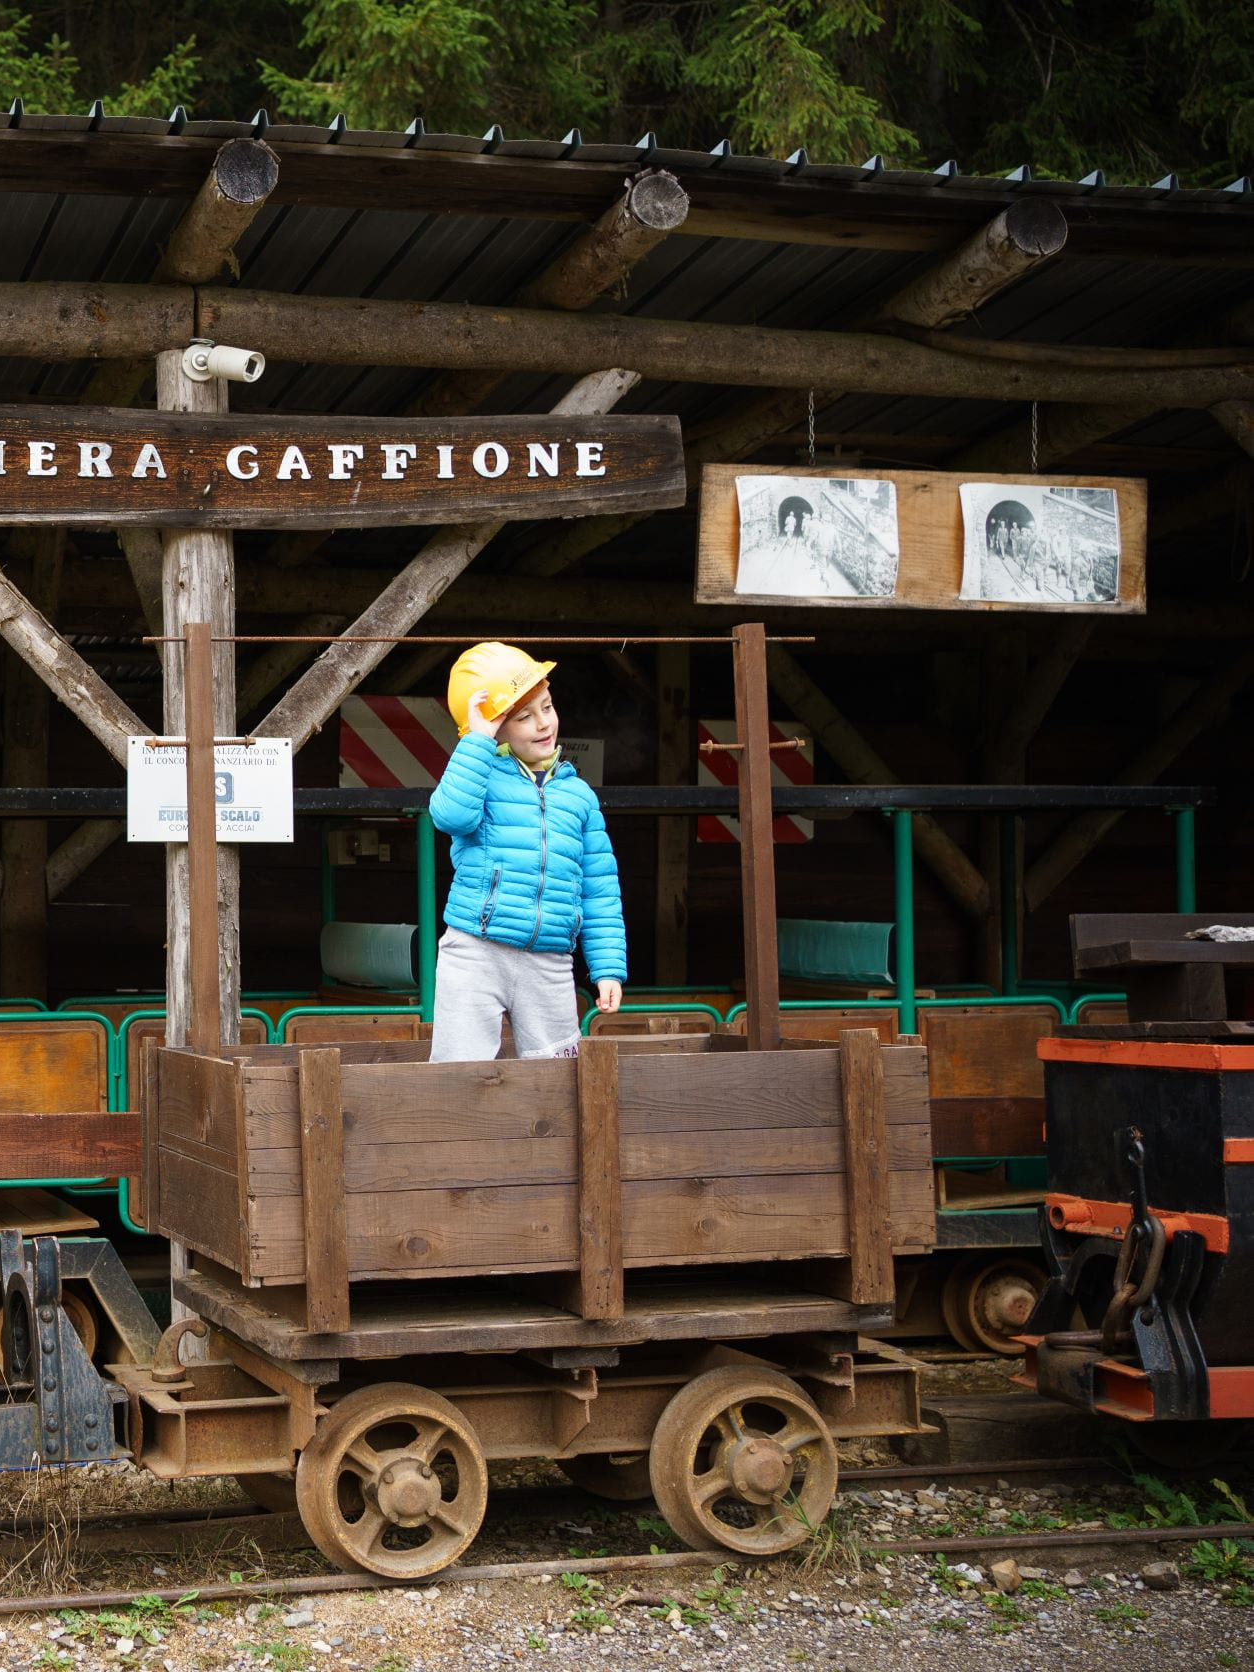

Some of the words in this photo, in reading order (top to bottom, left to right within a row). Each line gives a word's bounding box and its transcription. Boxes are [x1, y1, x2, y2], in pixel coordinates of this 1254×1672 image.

[225, 442, 607, 479] GAFFIONE
[215, 747, 259, 755] ALIZZATO
[144, 757, 154, 765] IL
[156, 757, 186, 765] CONCO
[214, 757, 263, 766] NANZIARIO
[220, 810, 261, 822] SCALO
[226, 824, 255, 832] ACCIAI
